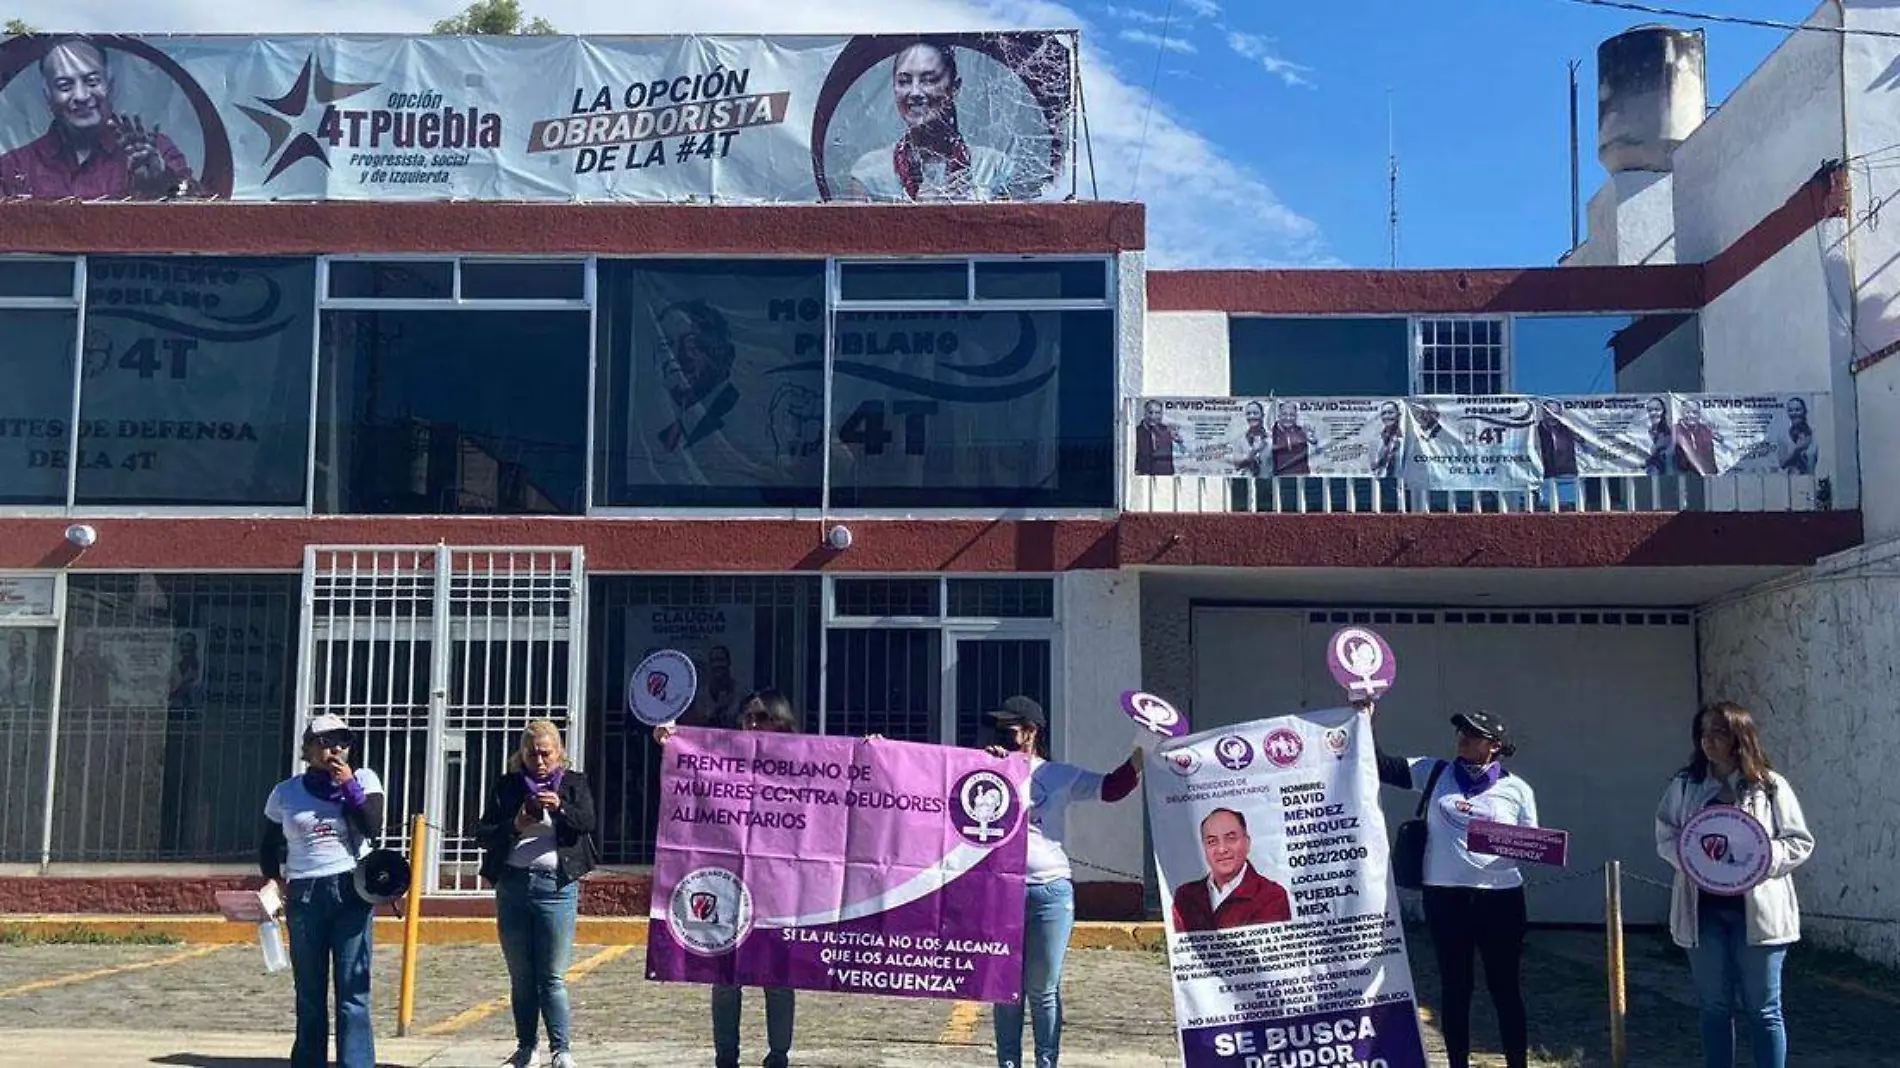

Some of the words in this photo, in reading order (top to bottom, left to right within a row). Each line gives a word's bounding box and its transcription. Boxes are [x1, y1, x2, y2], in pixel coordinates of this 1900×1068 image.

[572, 85, 612, 114] LA
[624, 64, 750, 109] OPCIÓN
[541, 96, 773, 149] OBRADORISTA
[575, 146, 620, 174] DE
[625, 140, 666, 170] LA
[676, 131, 740, 163] #4T
[359, 171, 367, 185] y
[370, 169, 385, 184] de
[118, 337, 199, 380] 4T
[116, 419, 258, 442] DEFENSA
[839, 399, 939, 456] 4T
[1479, 427, 1506, 444] 4T
[676, 753, 746, 774] FRENTE
[752, 758, 842, 780] POBLANO
[848, 764, 872, 781] DE
[672, 779, 753, 801] MUJERES
[760, 784, 839, 807] CONTRA
[846, 789, 943, 814] DEUDORES
[1282, 792, 1325, 807] DAVID
[670, 805, 806, 830] ALIMENTARIOS
[1289, 846, 1368, 868] 0052/2009
[1294, 884, 1360, 902] PUEBLA,
[1296, 902, 1331, 917] MEX
[800, 929, 819, 943] LA
[822, 931, 885, 948] JUSTICIA
[889, 936, 911, 949] NO
[915, 937, 943, 951] LOS
[944, 940, 1010, 956] ALCANZA
[820, 948, 851, 965] QUE
[854, 951, 882, 965] LOS
[885, 953, 952, 970] ALCANCE
[955, 958, 975, 971] LA
[1267, 989, 1282, 999] LO
[1187, 1017, 1204, 1026] NO
[1302, 1004, 1316, 1013] EL
[1214, 1031, 1256, 1057] SE
[1265, 1016, 1377, 1051] BUSCA
[1244, 1044, 1355, 1068] DEUDOR
